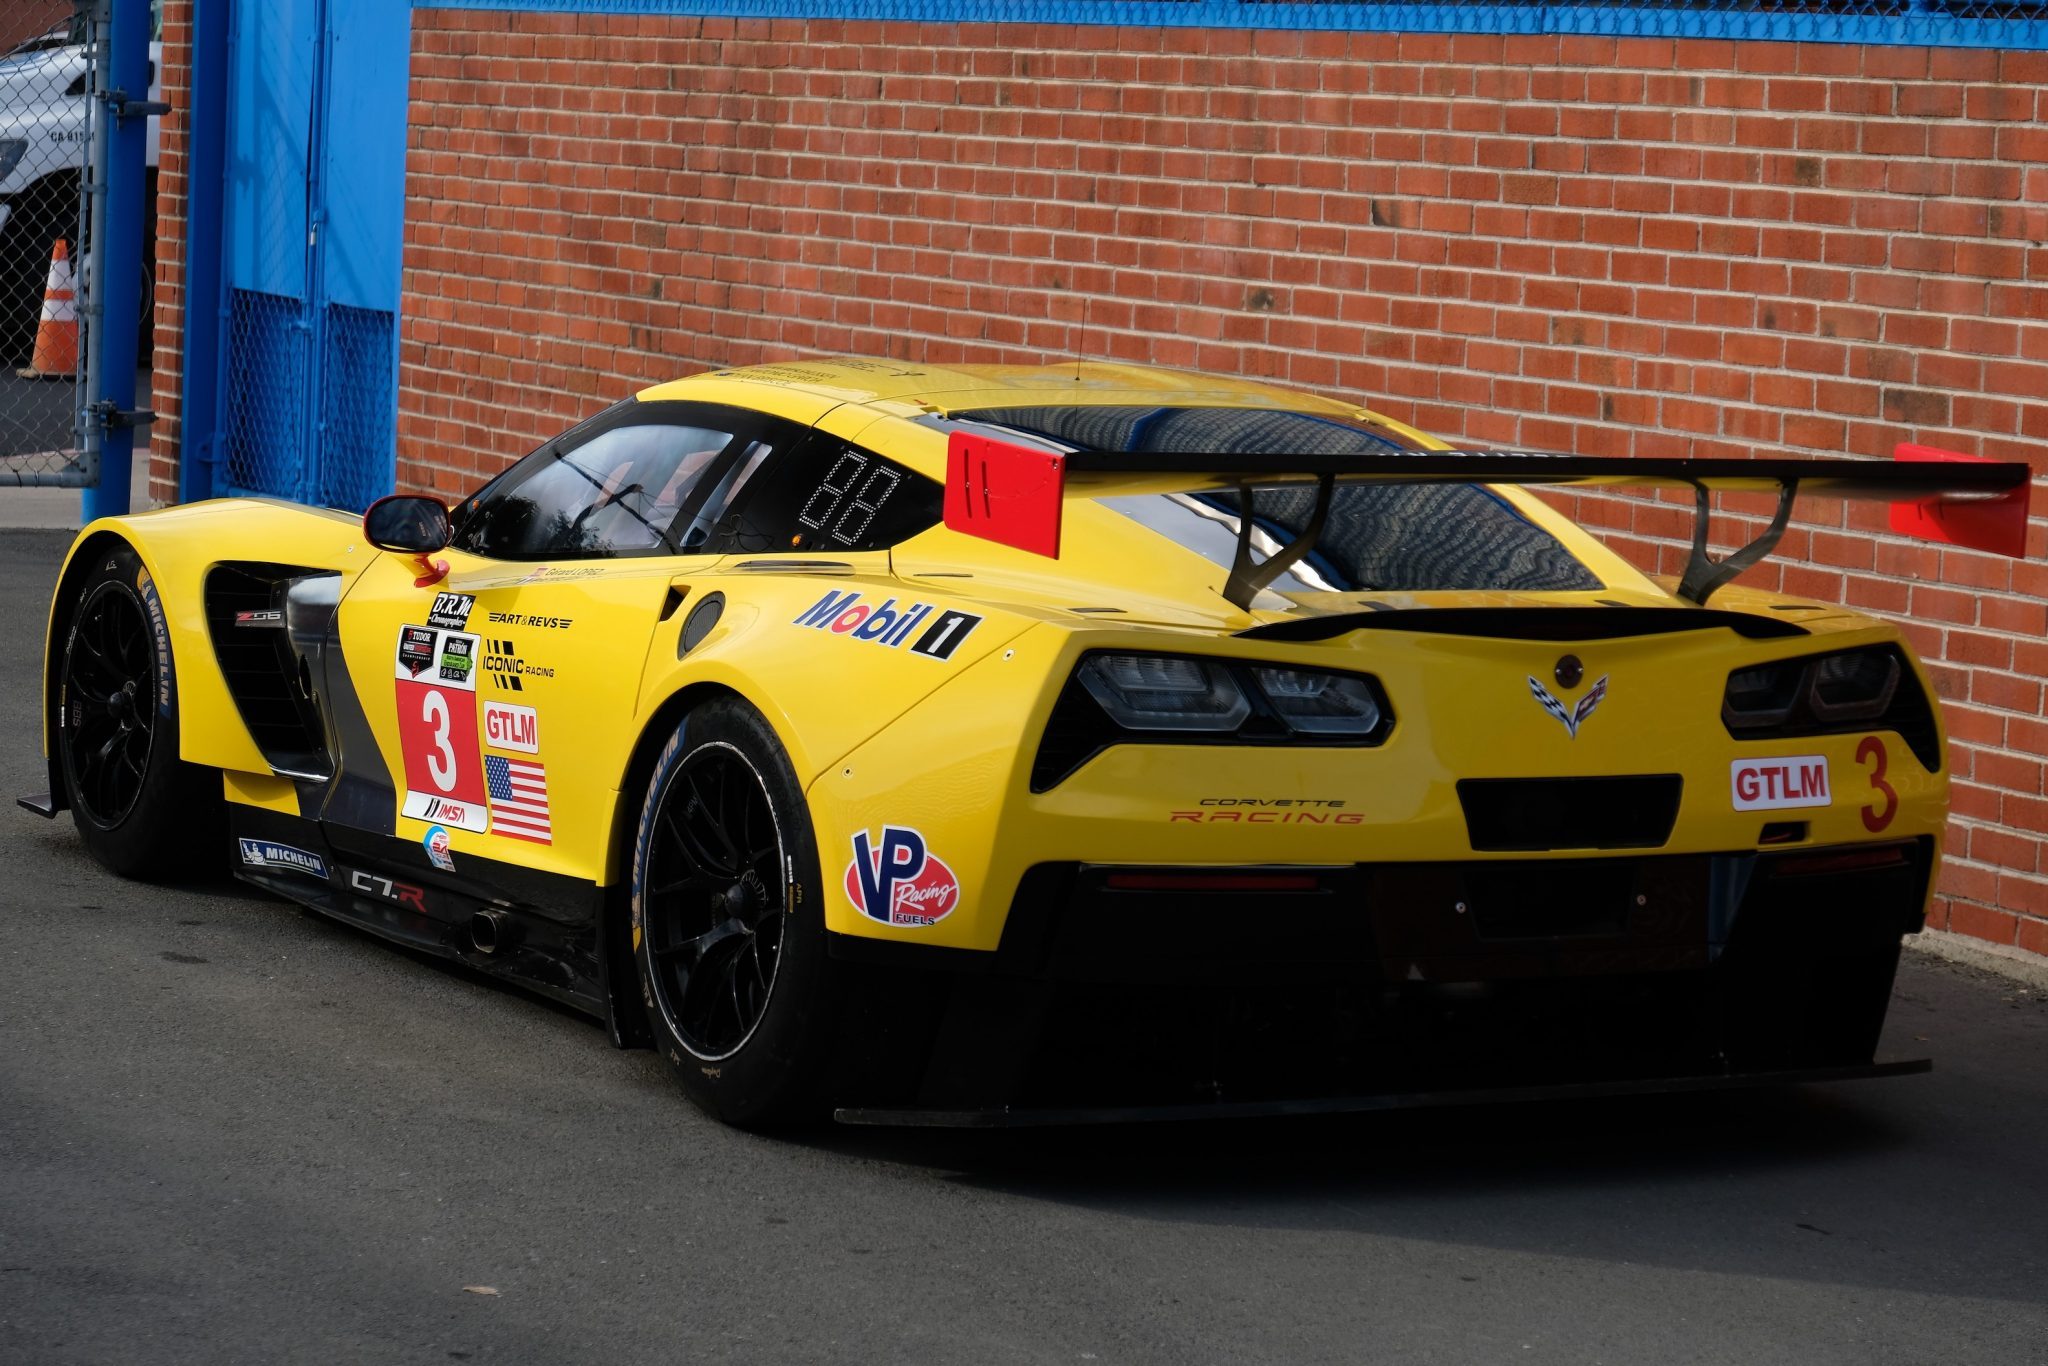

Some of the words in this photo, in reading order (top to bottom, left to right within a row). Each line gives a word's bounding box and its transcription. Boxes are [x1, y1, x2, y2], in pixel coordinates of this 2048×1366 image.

[792, 589, 935, 647] Mobil
[147, 598, 169, 707] MICHELIN
[413, 631, 432, 642] TUDOR
[482, 655, 525, 674] ICONIC
[525, 665, 555, 678] RACING
[422, 689, 457, 792] 3
[486, 708, 536, 746] GTLM
[1736, 764, 1827, 802] GTLM
[1854, 735, 1899, 834] 3
[437, 803, 465, 824] IMSA
[633, 725, 681, 887] MICHELIN
[1169, 811, 1366, 825] RACING
[1199, 798, 1347, 808] CORVETTE
[265, 847, 322, 872] MICHELIN
[853, 828, 925, 923] VP
[895, 880, 958, 912] Racing
[895, 913, 935, 926] FUELS
